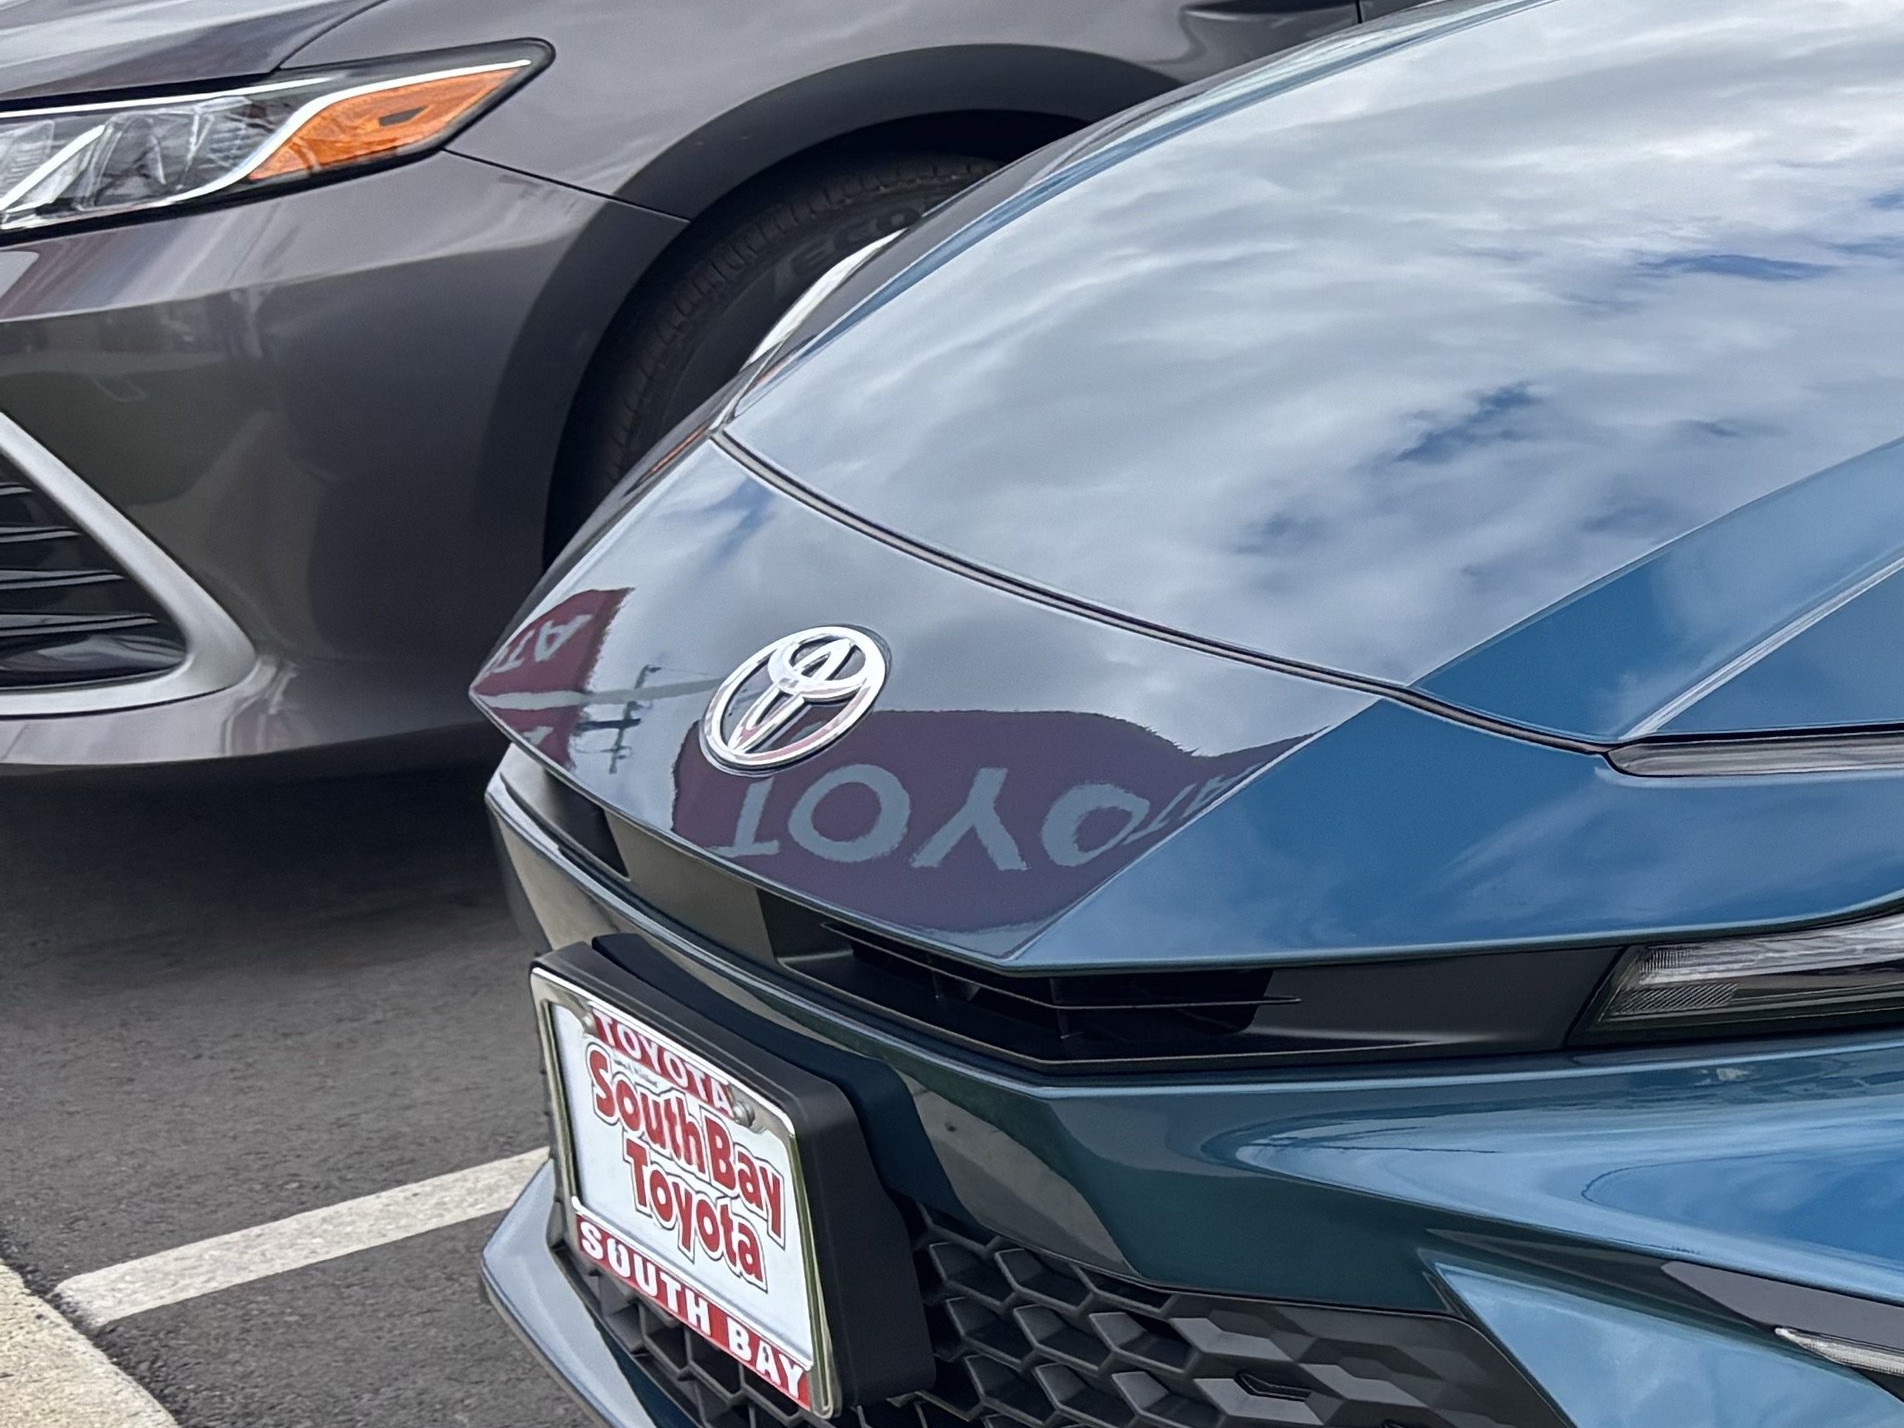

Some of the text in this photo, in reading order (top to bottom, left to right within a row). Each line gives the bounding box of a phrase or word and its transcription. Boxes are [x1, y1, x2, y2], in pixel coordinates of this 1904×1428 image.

[599, 1012, 733, 1116] TOYOTA
[626, 1143, 764, 1284] Toyota
[579, 1218, 806, 1399] SOUTH BAY
